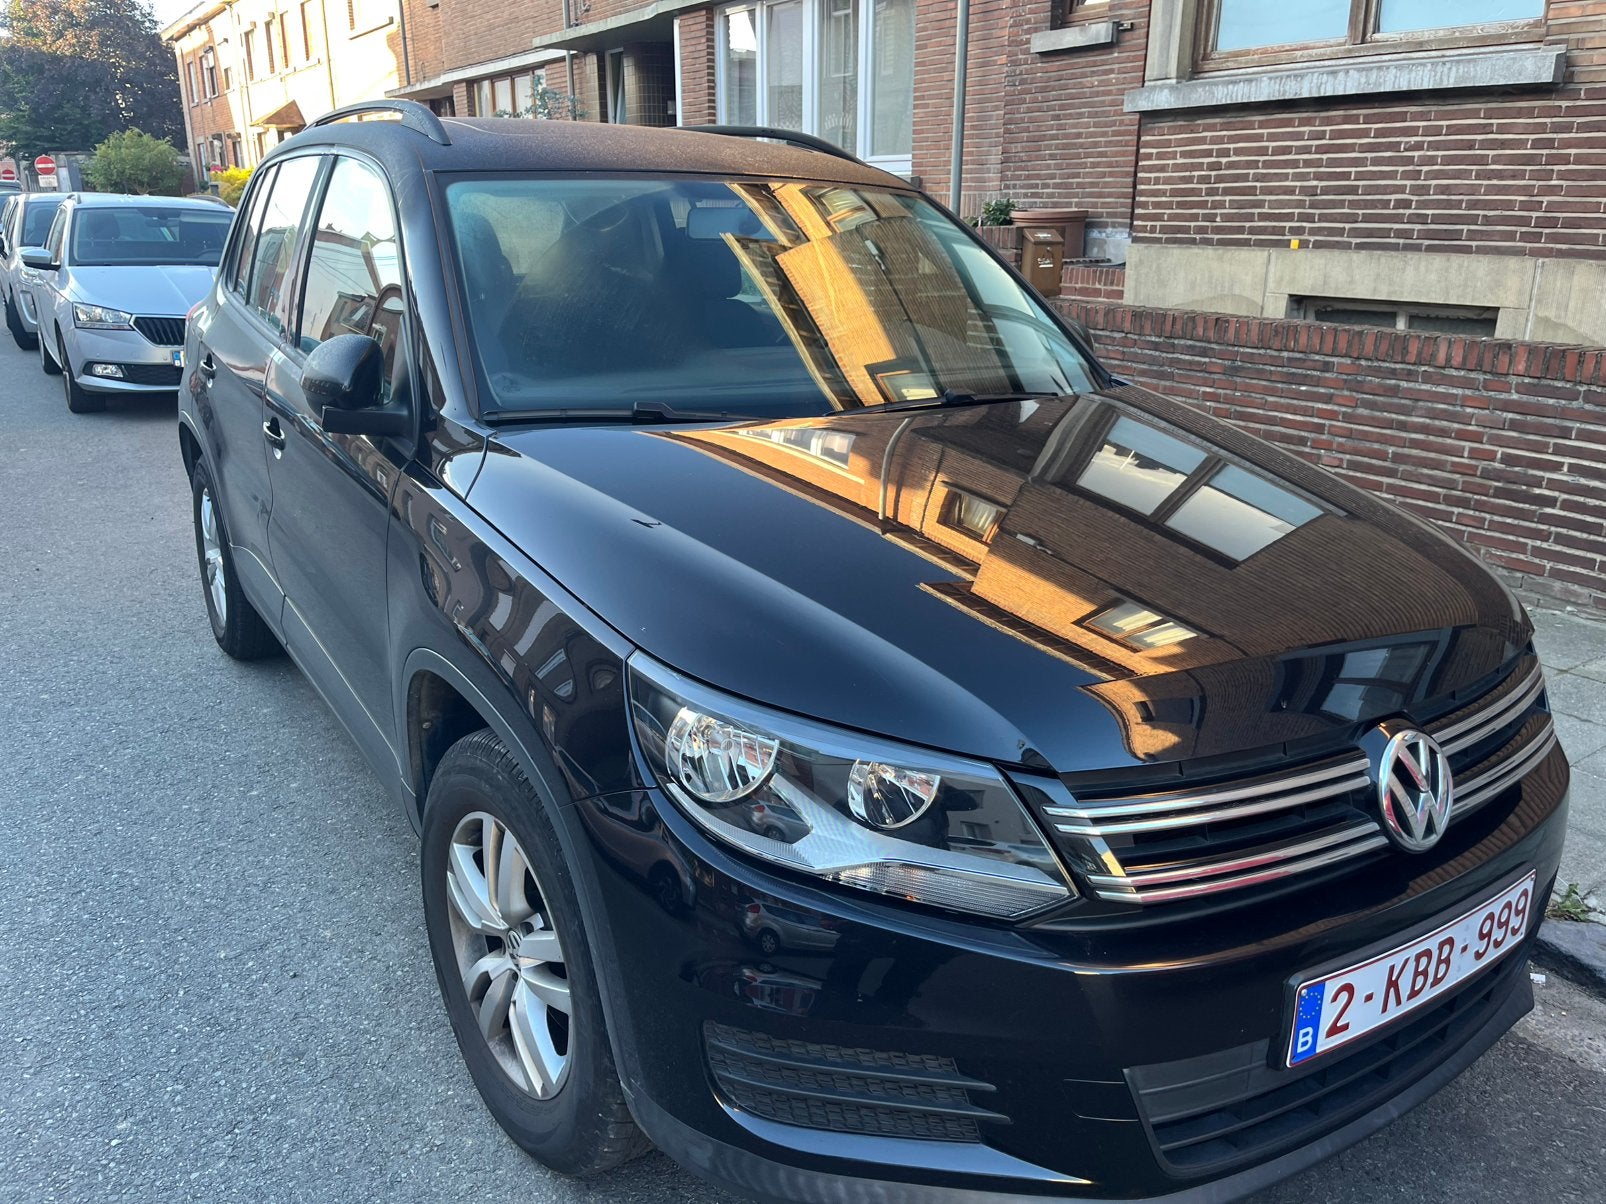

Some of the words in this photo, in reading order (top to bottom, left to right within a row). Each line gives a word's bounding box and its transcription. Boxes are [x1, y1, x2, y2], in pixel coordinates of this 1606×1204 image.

[1382, 732, 1451, 847] VW
[1324, 887, 1529, 1039] 2-KBB-999
[1296, 1026, 1314, 1054] B
